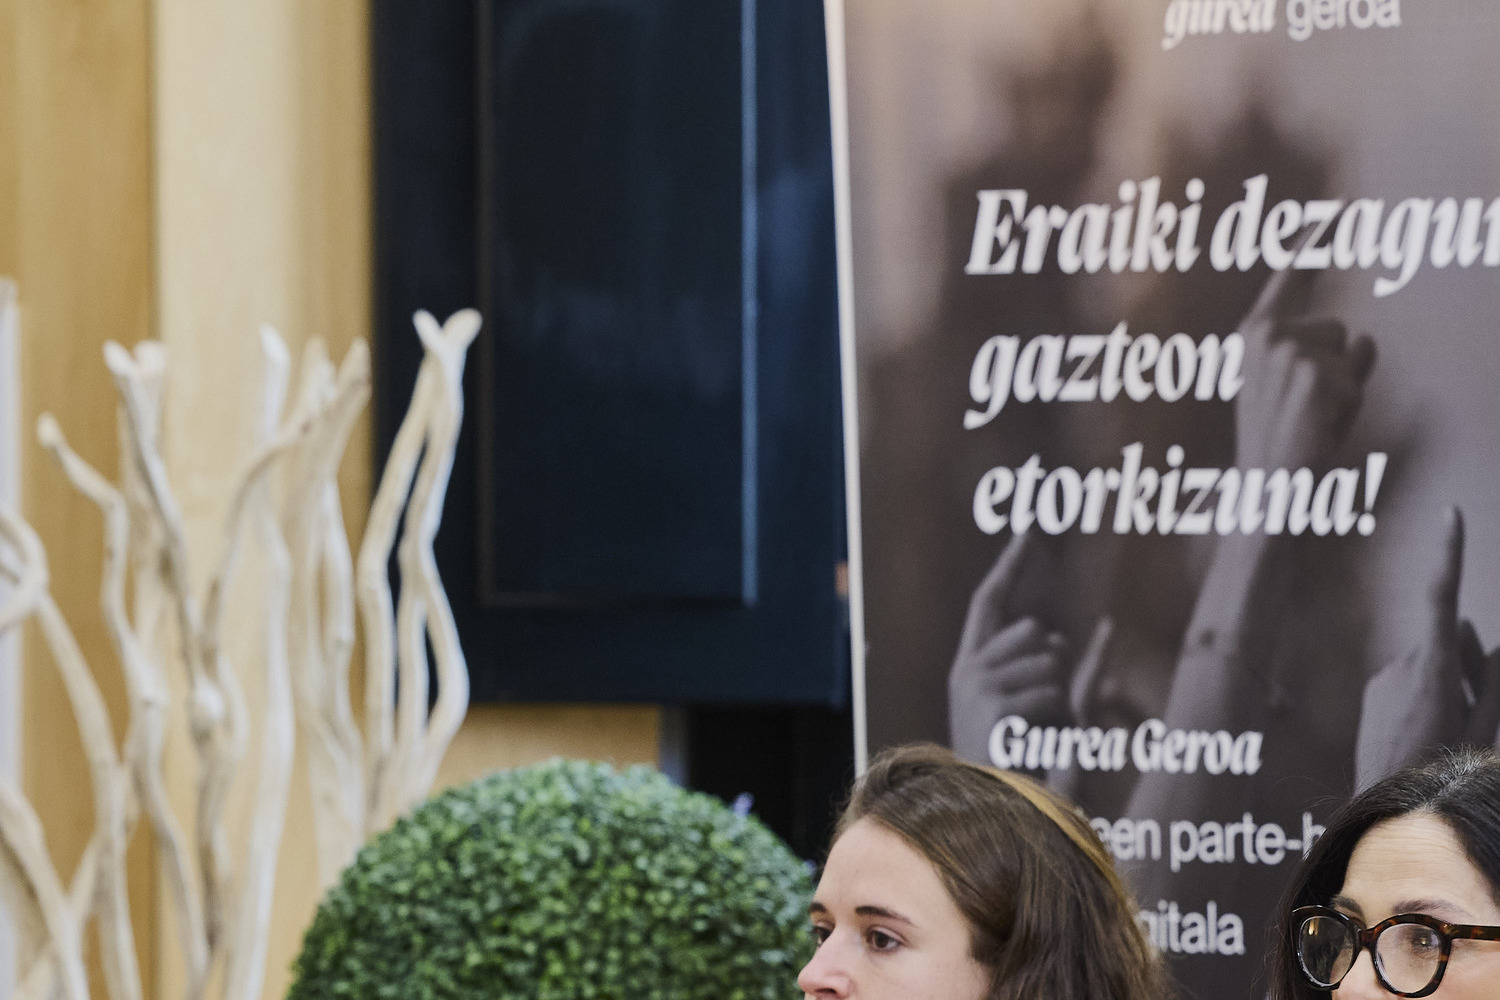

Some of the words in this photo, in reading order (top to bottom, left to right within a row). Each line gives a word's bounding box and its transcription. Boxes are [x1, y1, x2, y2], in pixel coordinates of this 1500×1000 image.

[964, 176, 1206, 275] Eraiki
[963, 321, 1245, 430] gazteon
[972, 441, 1388, 536] etorkizuna!
[988, 715, 1126, 772] Gurea
[1131, 718, 1264, 775] Geroa
